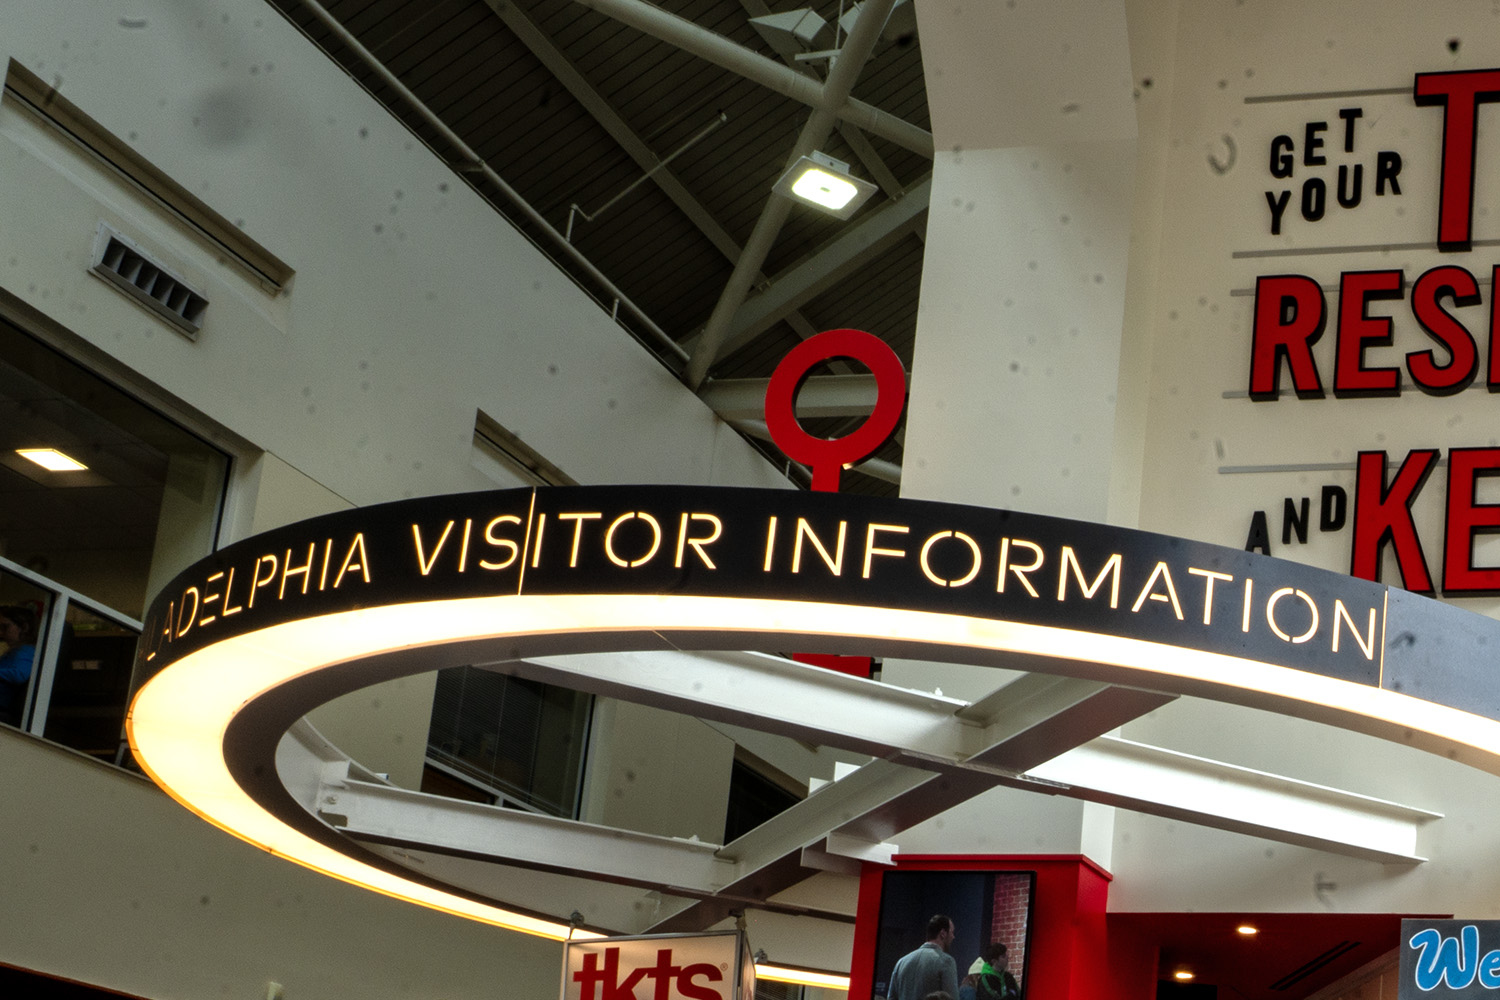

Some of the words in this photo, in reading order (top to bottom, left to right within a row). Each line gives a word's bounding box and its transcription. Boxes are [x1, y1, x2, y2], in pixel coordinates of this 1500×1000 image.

[1269, 108, 1363, 180] GET
[1265, 151, 1402, 235] YOUR
[1244, 485, 1347, 555] AND
[411, 511, 723, 578] VISITOR
[764, 514, 1377, 661] INFORMATION
